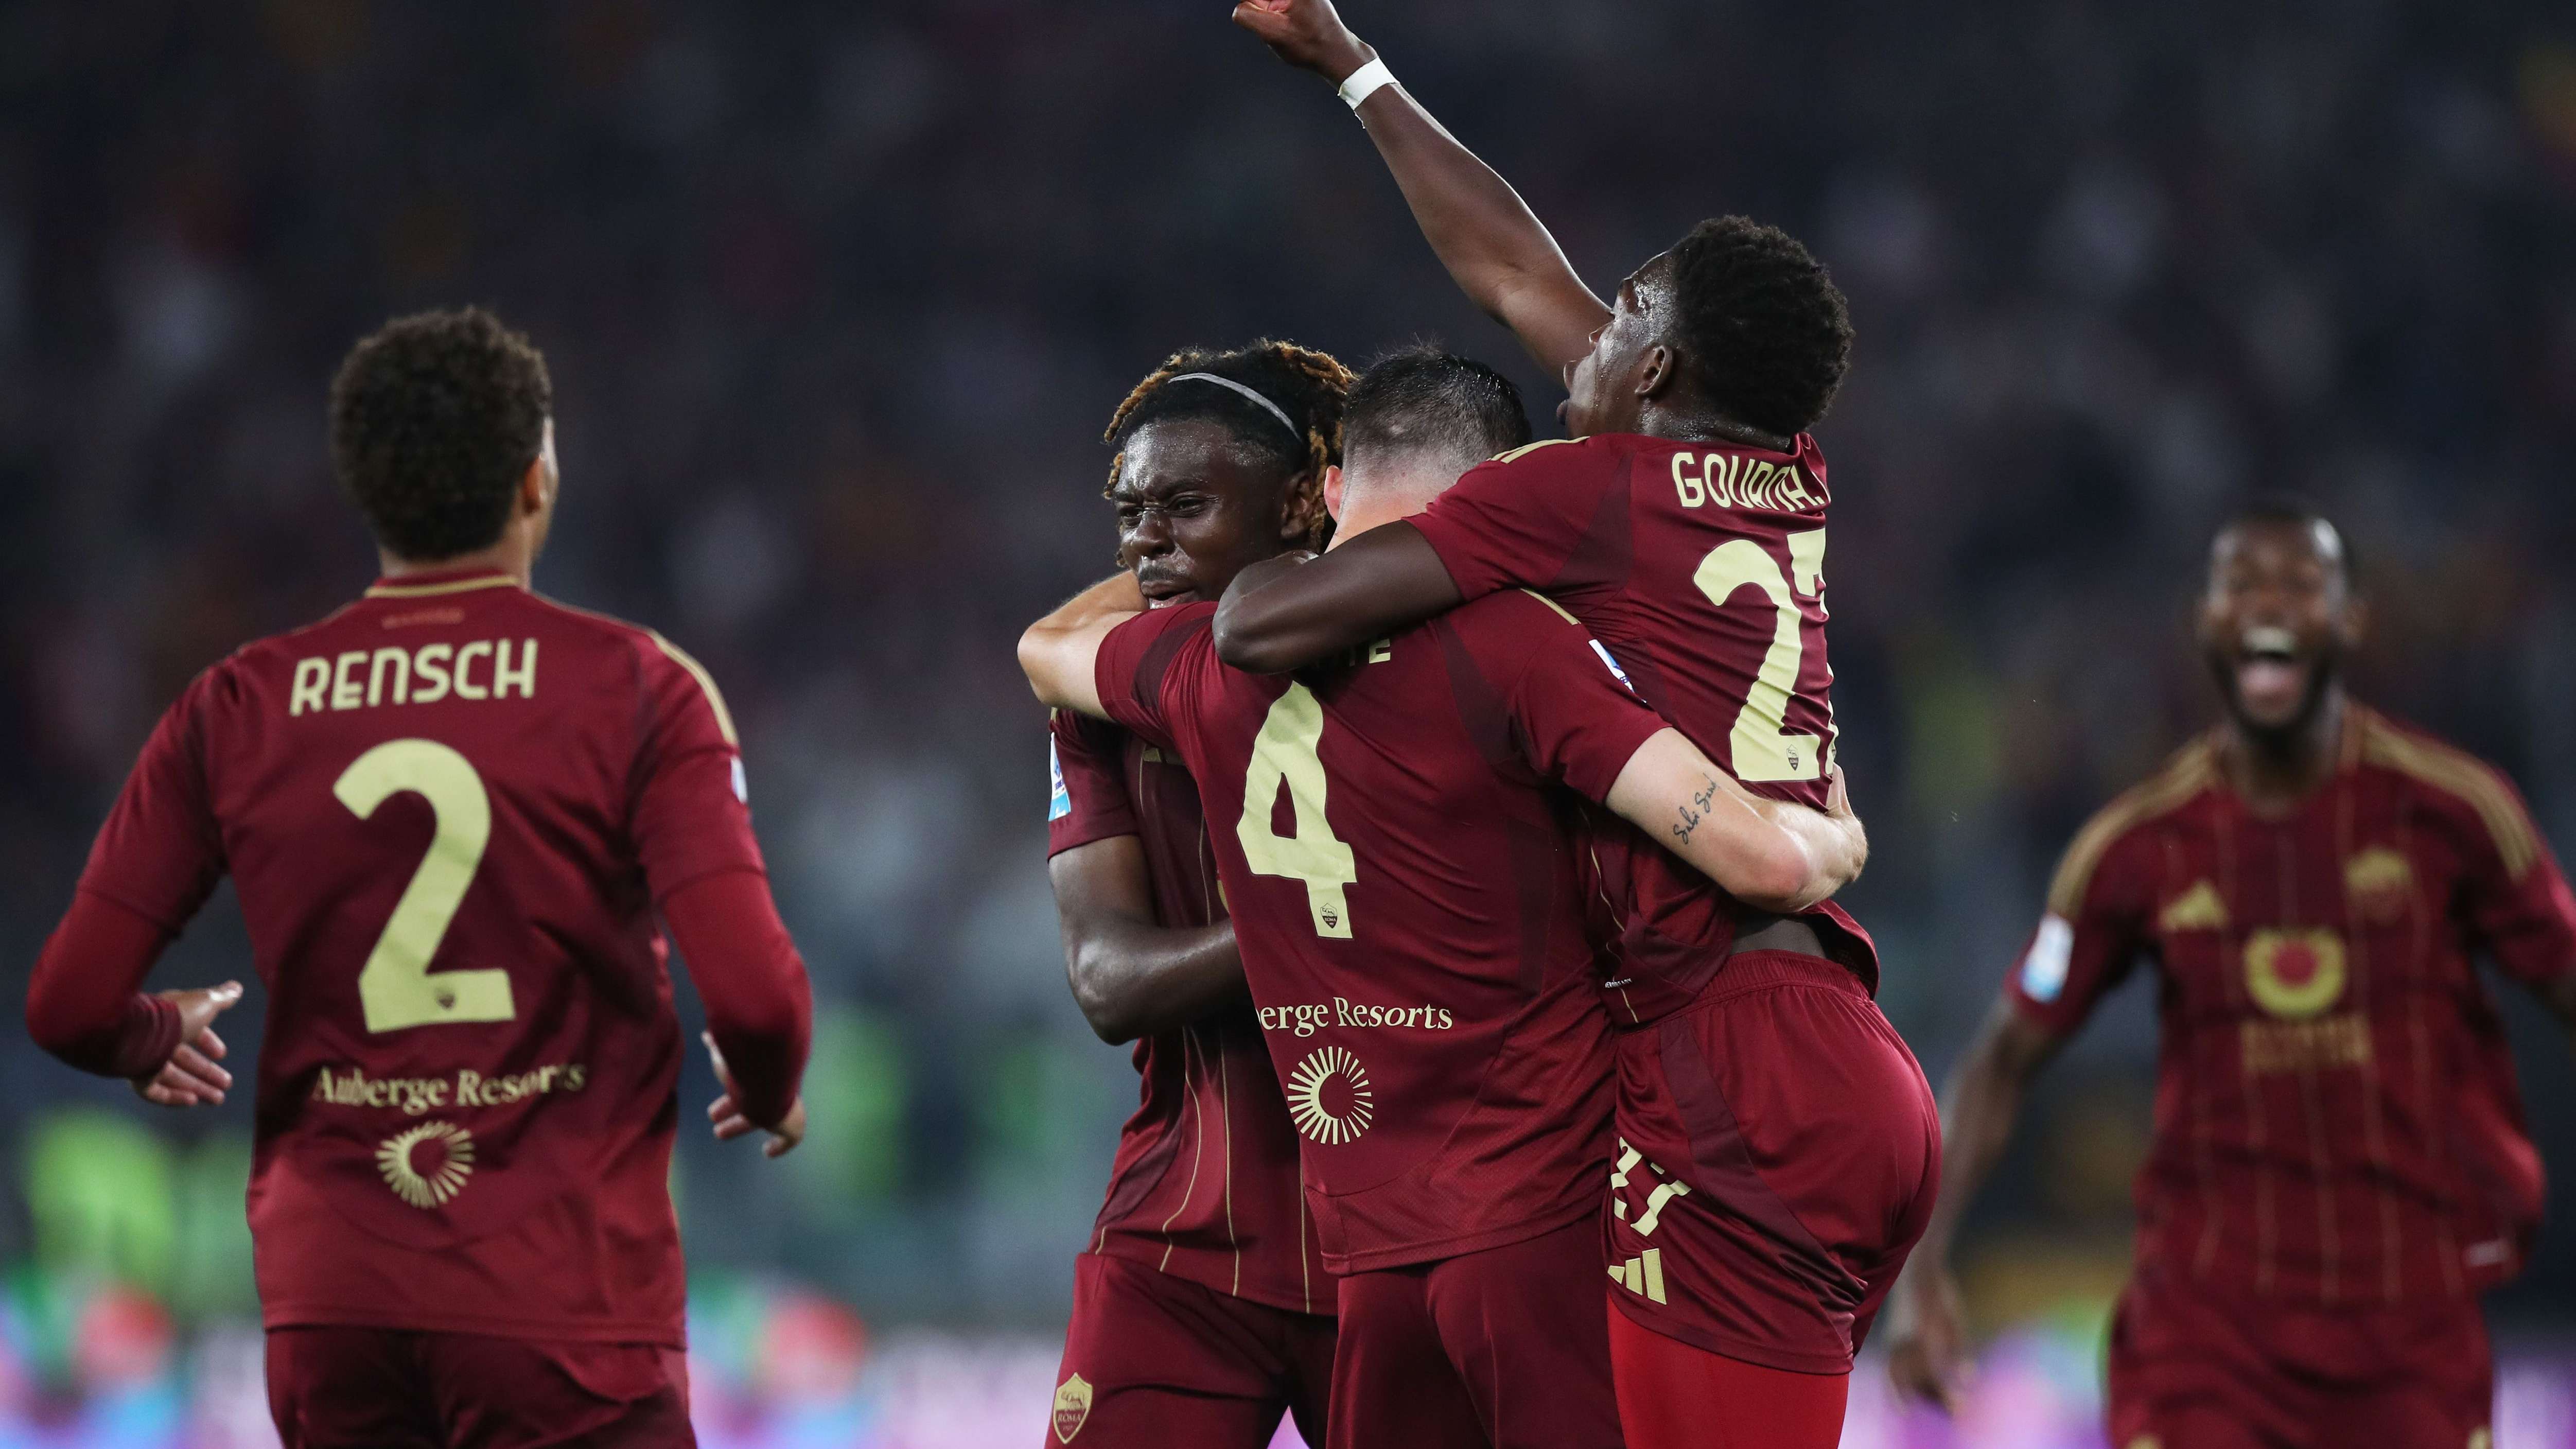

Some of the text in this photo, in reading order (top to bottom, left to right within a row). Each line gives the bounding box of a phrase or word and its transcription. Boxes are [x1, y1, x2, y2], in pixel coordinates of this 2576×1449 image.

[289, 638, 538, 716] RENSCH
[1236, 680, 1357, 939] 4
[333, 738, 515, 1034] 2
[1256, 997, 1452, 1037] erge Resorts
[456, 1063, 586, 1107] Resors
[1058, 1412, 1081, 1423] ROMA
